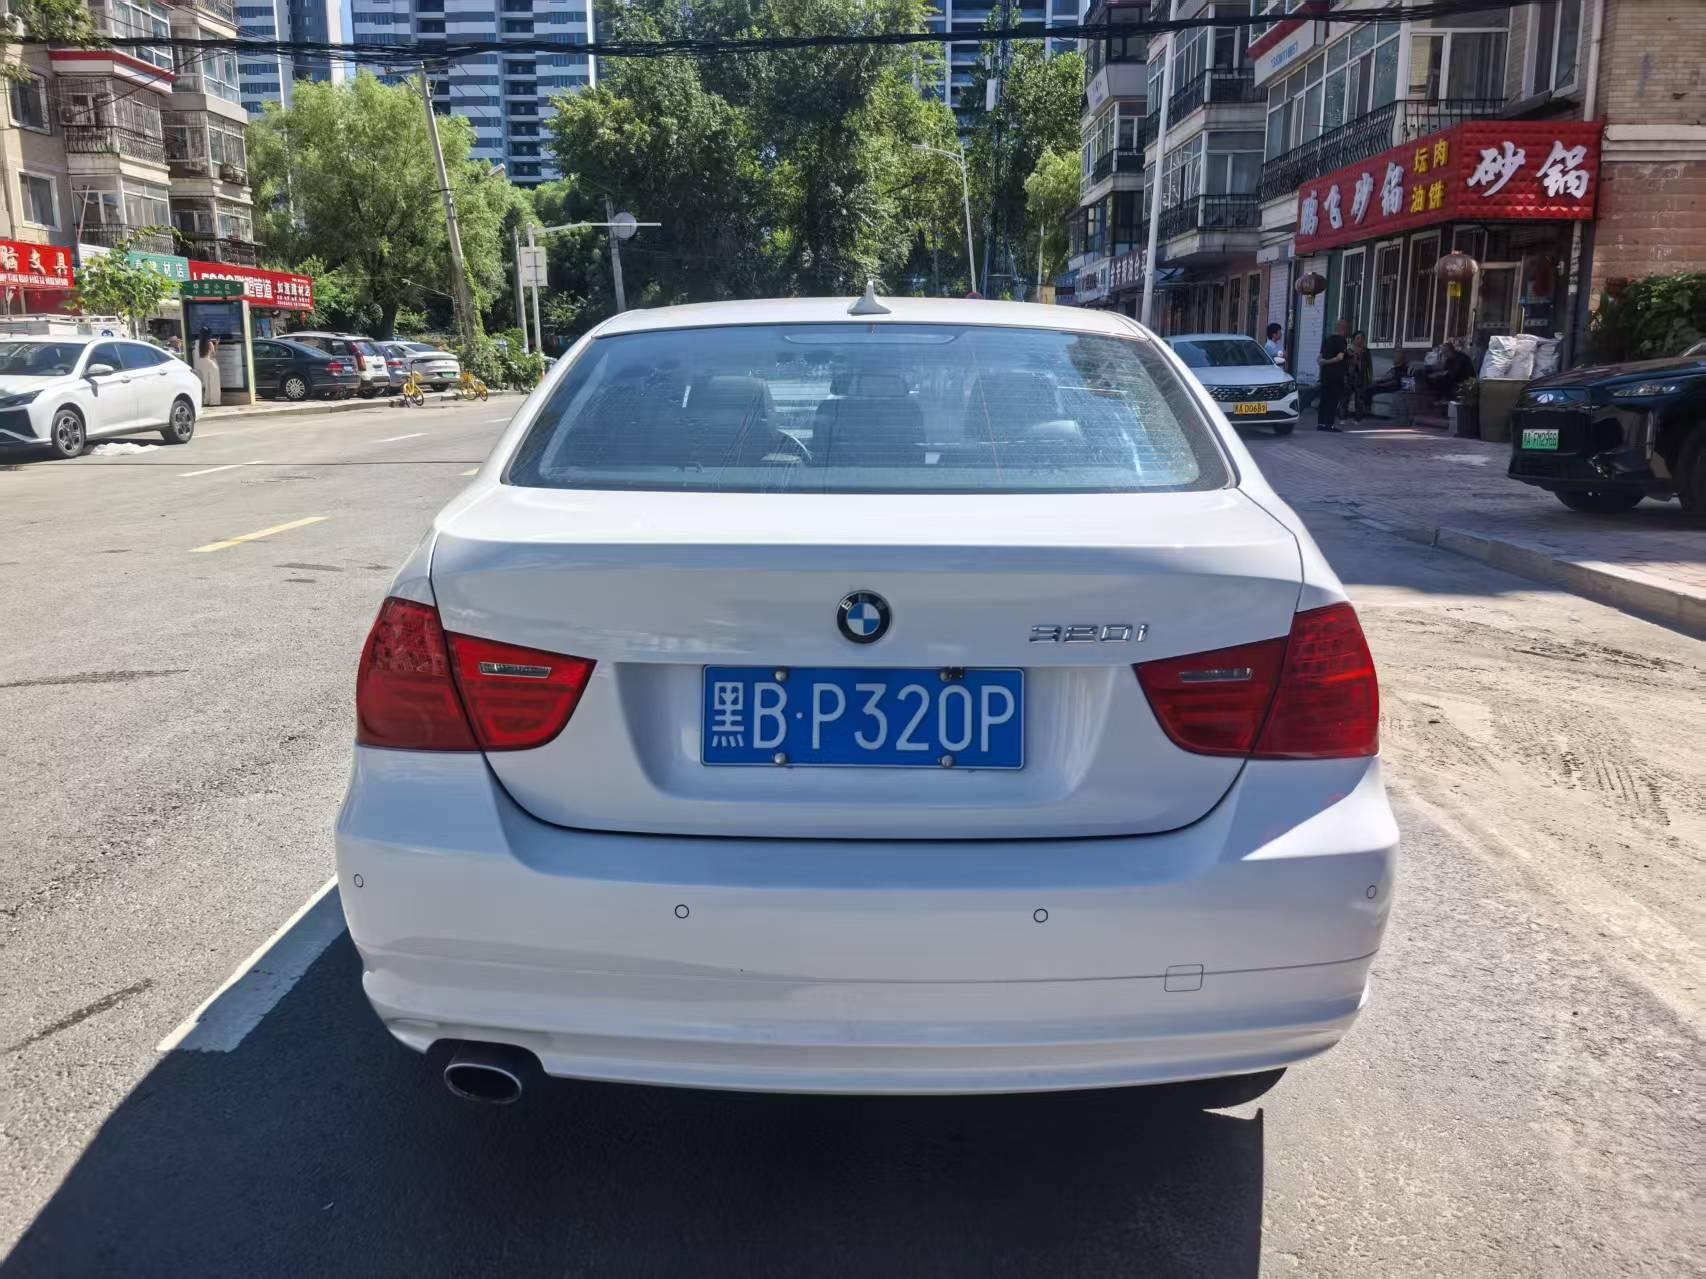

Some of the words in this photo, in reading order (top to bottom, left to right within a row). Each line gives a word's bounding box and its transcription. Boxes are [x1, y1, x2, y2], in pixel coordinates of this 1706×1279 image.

[1467, 140, 1590, 199] 砂锅
[1029, 624, 1148, 643] 320i
[711, 681, 1016, 753] 黑B·P320P
